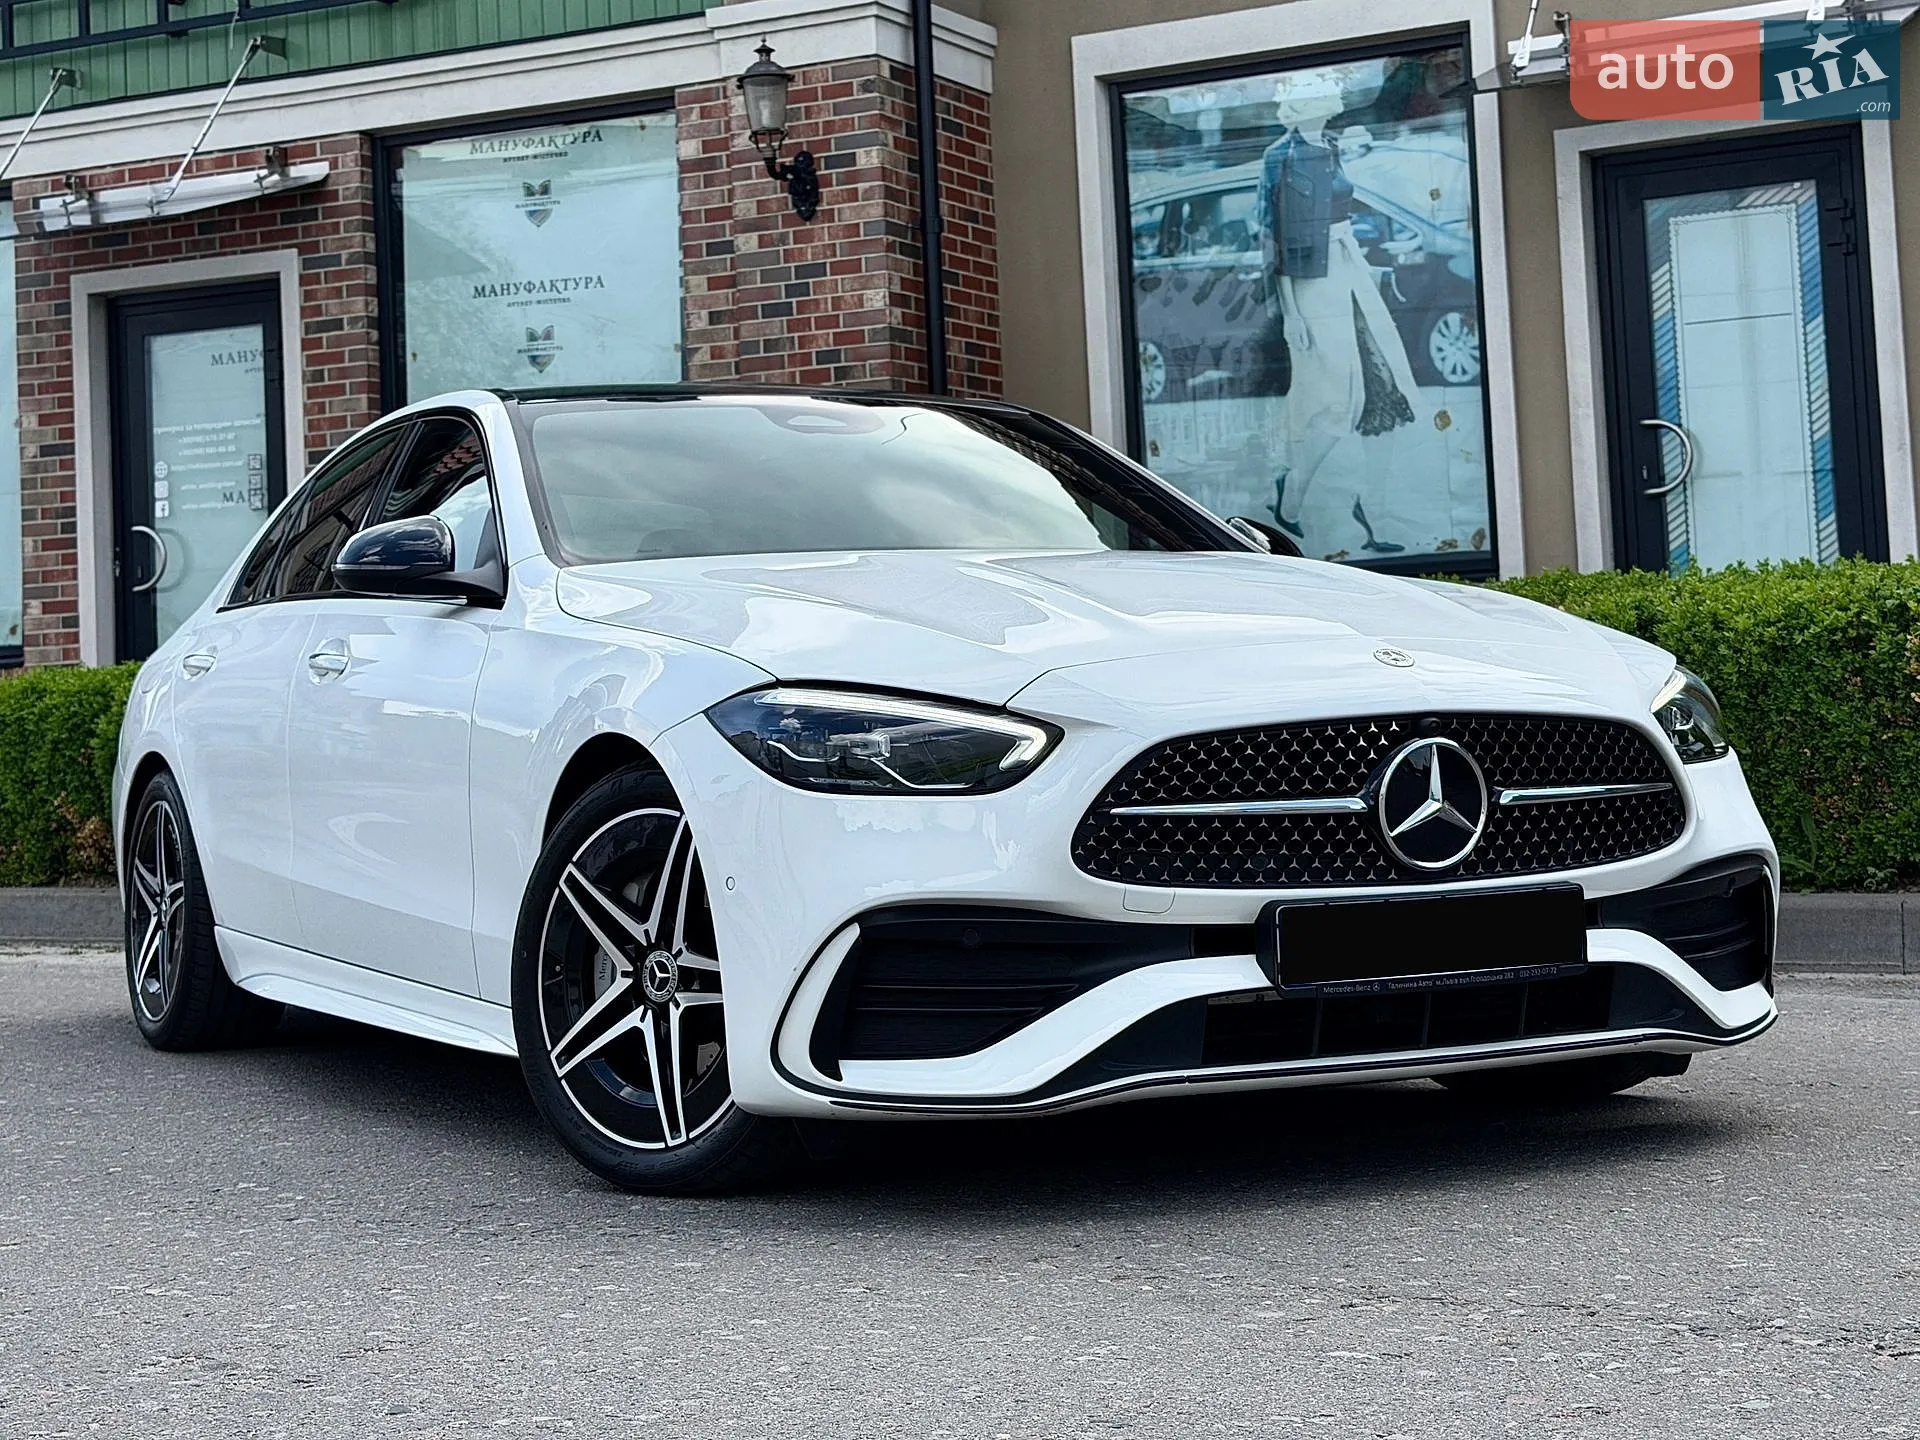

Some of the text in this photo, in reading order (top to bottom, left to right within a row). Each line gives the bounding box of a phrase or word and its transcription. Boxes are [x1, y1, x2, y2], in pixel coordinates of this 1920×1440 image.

[469, 129, 603, 155] МАНУФАКТУРА
[472, 275, 606, 299] МАНУФАКТУРА
[1323, 983, 1371, 993] Mercedes-Benz
